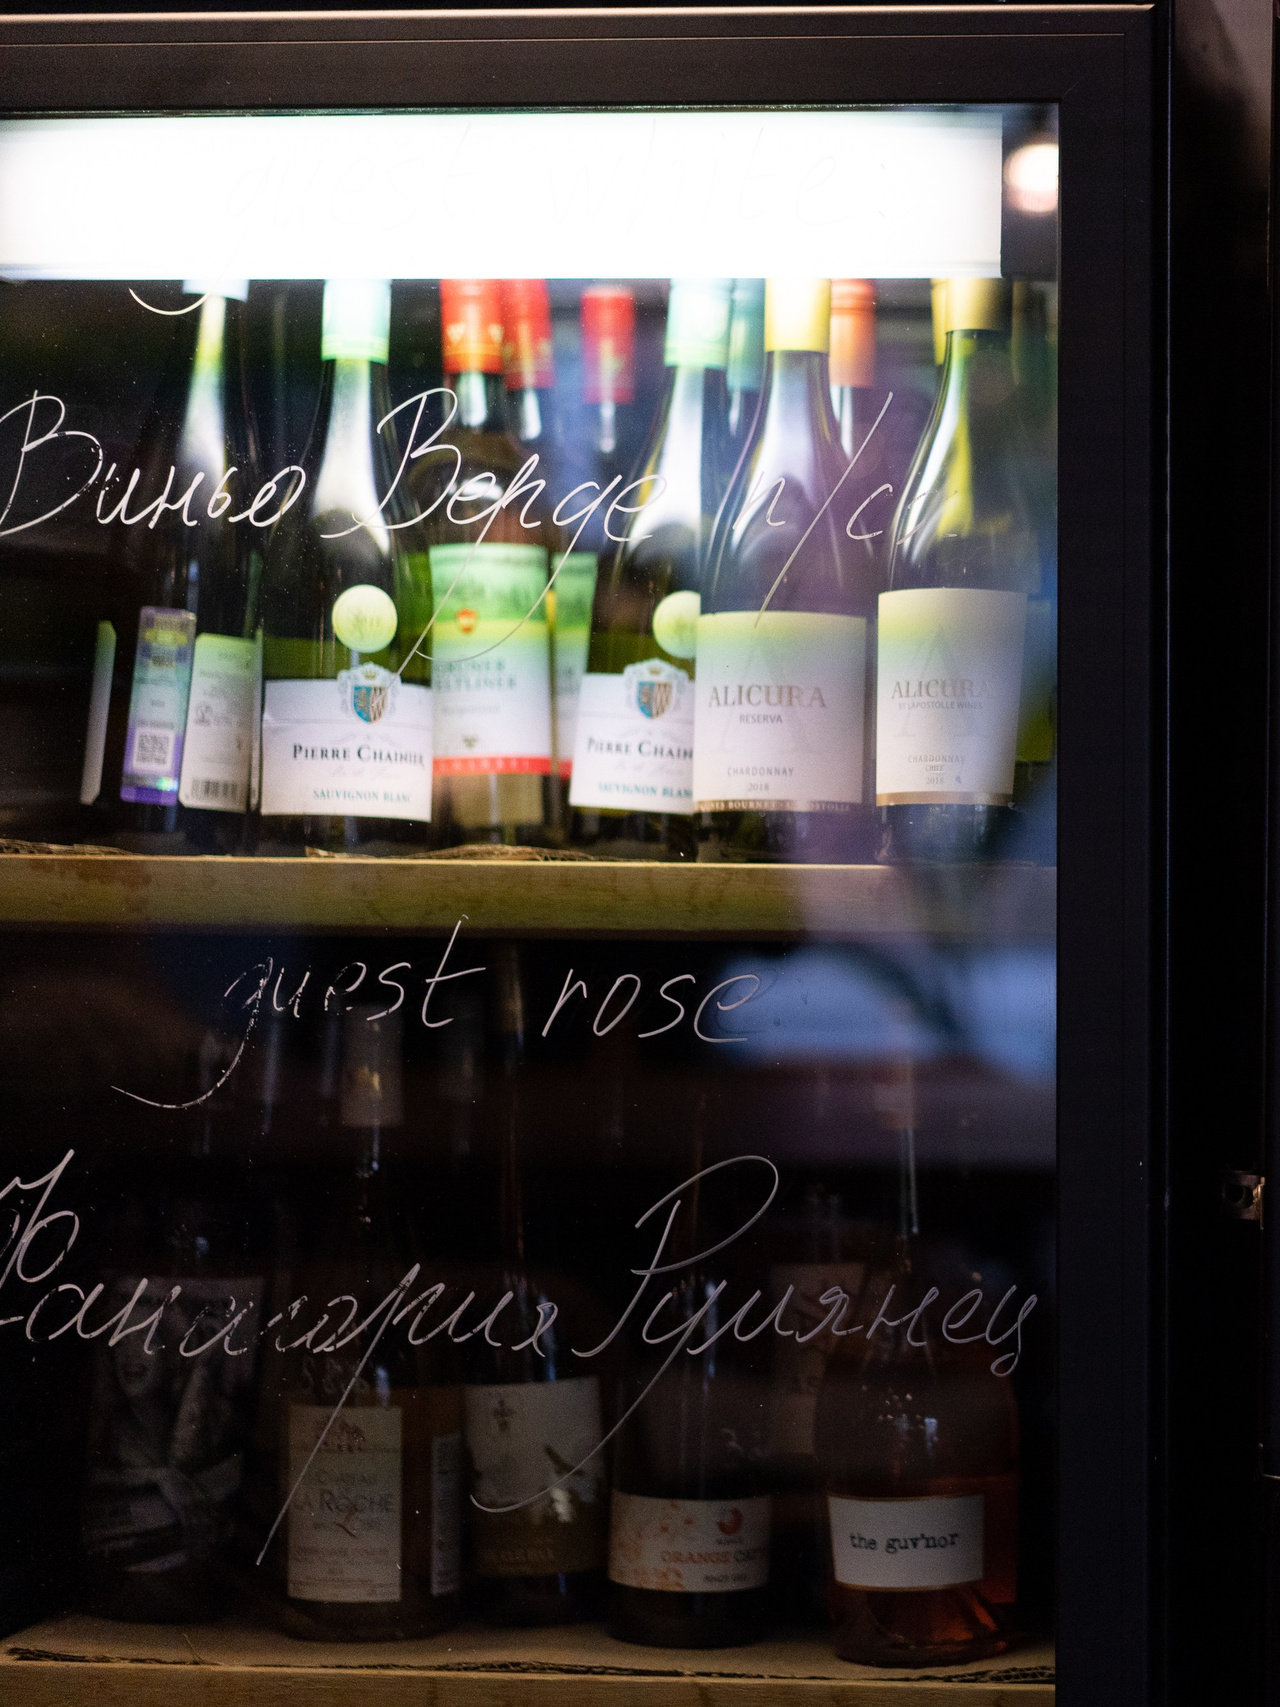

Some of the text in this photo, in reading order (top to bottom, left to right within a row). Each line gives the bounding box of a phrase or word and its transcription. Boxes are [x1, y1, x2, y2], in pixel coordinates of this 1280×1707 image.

[320, 386, 669, 706] Верде
[708, 683, 827, 709] ALICURA
[110, 914, 763, 1109] guest rose
[849, 1531, 959, 1554] the guv'nor
